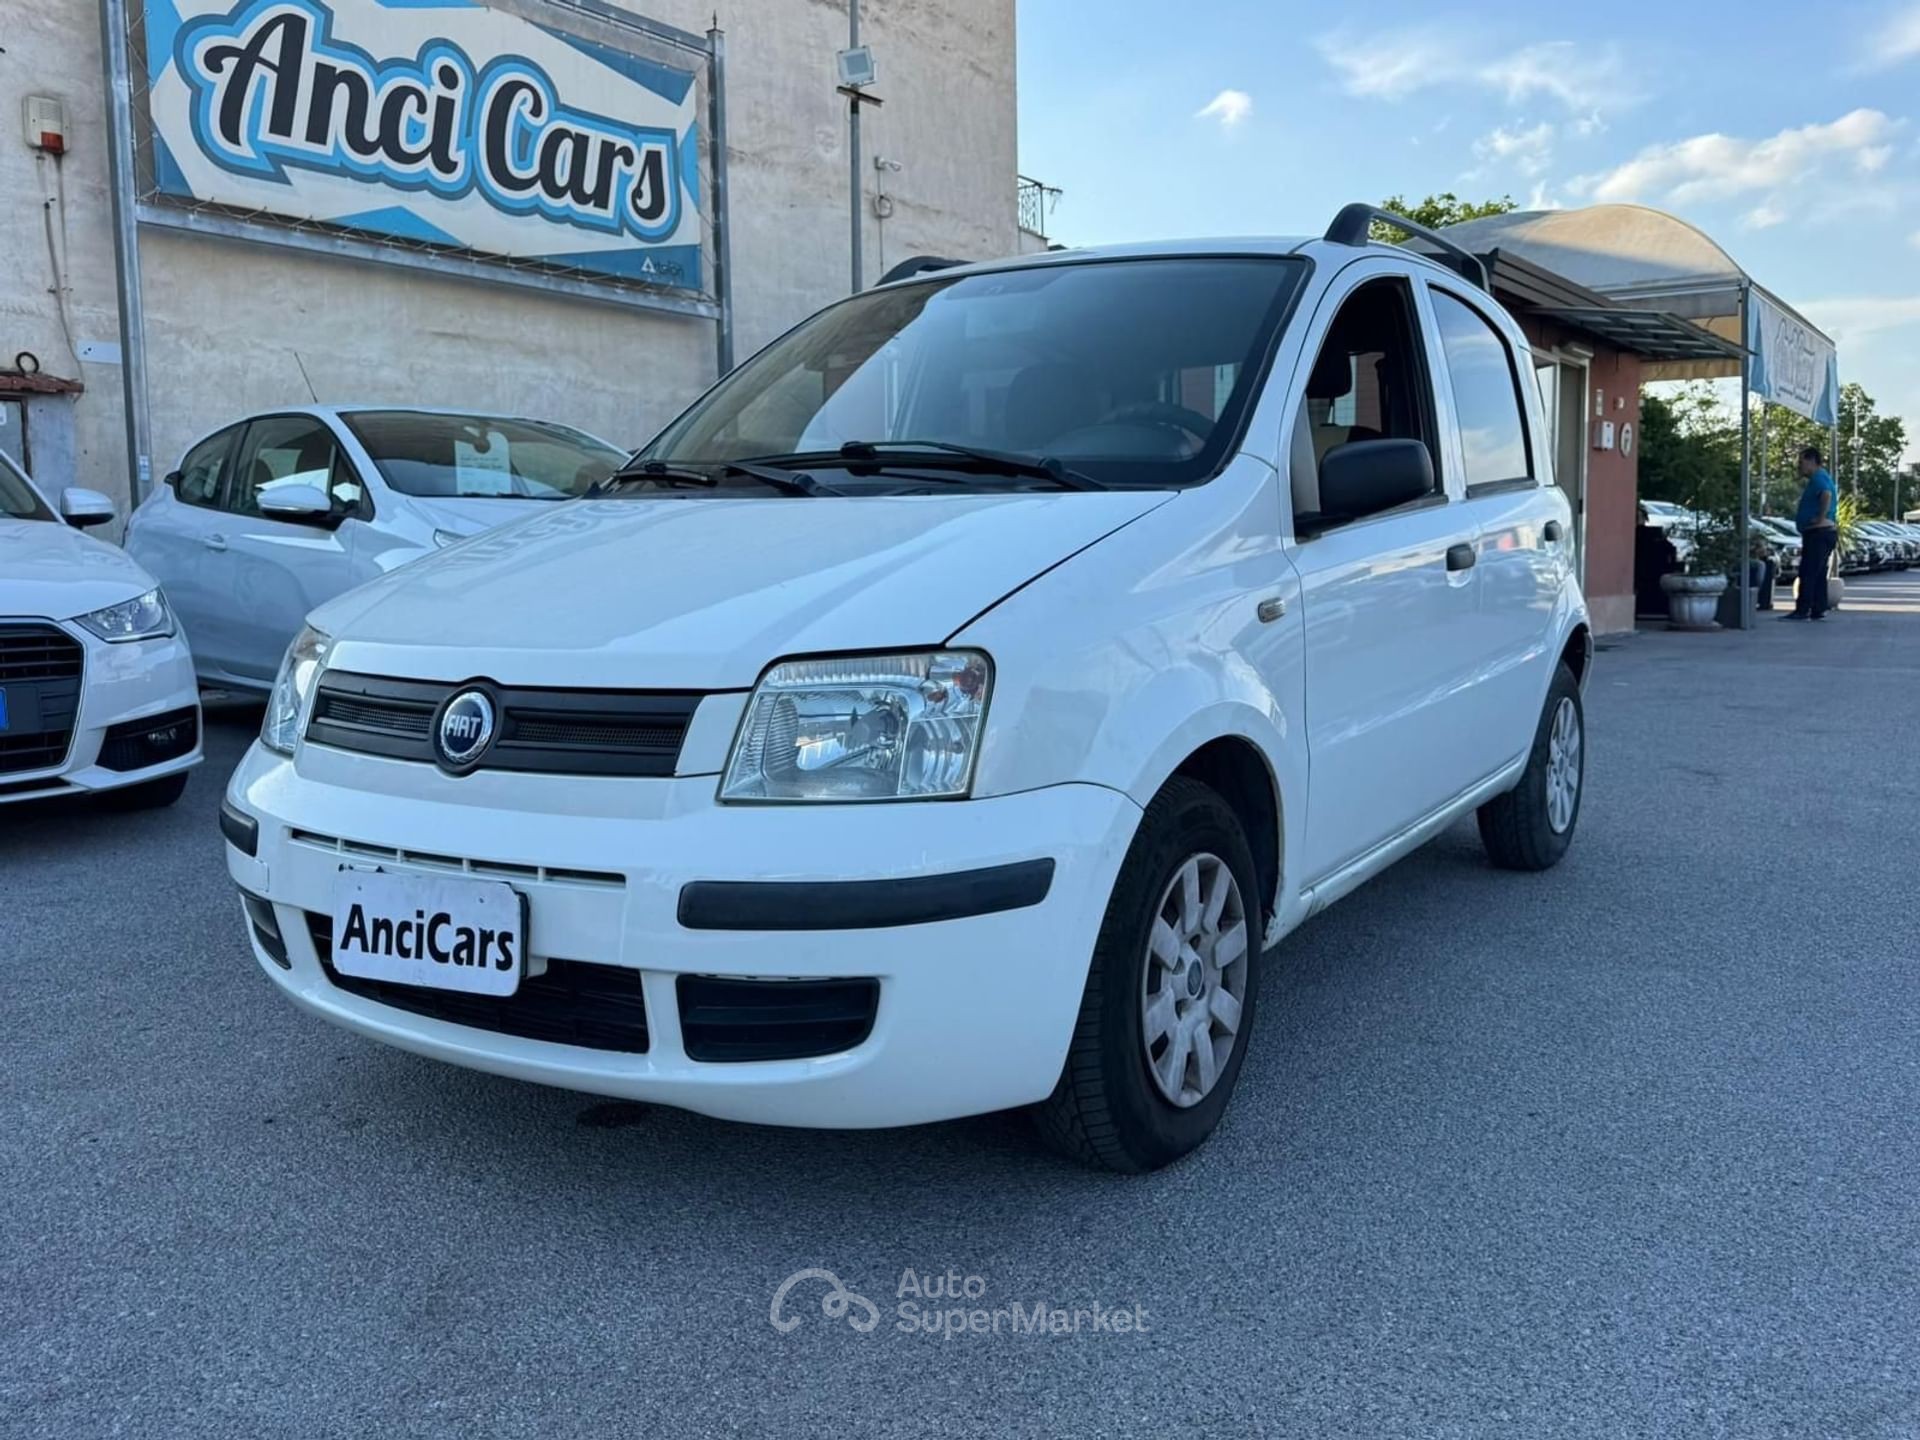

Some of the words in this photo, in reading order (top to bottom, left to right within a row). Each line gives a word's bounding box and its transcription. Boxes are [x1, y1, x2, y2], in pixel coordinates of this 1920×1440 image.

[203, 13, 460, 175] Anci
[485, 80, 667, 221] Cars
[446, 714, 481, 739] FIAT
[340, 903, 514, 972] AnciCars
